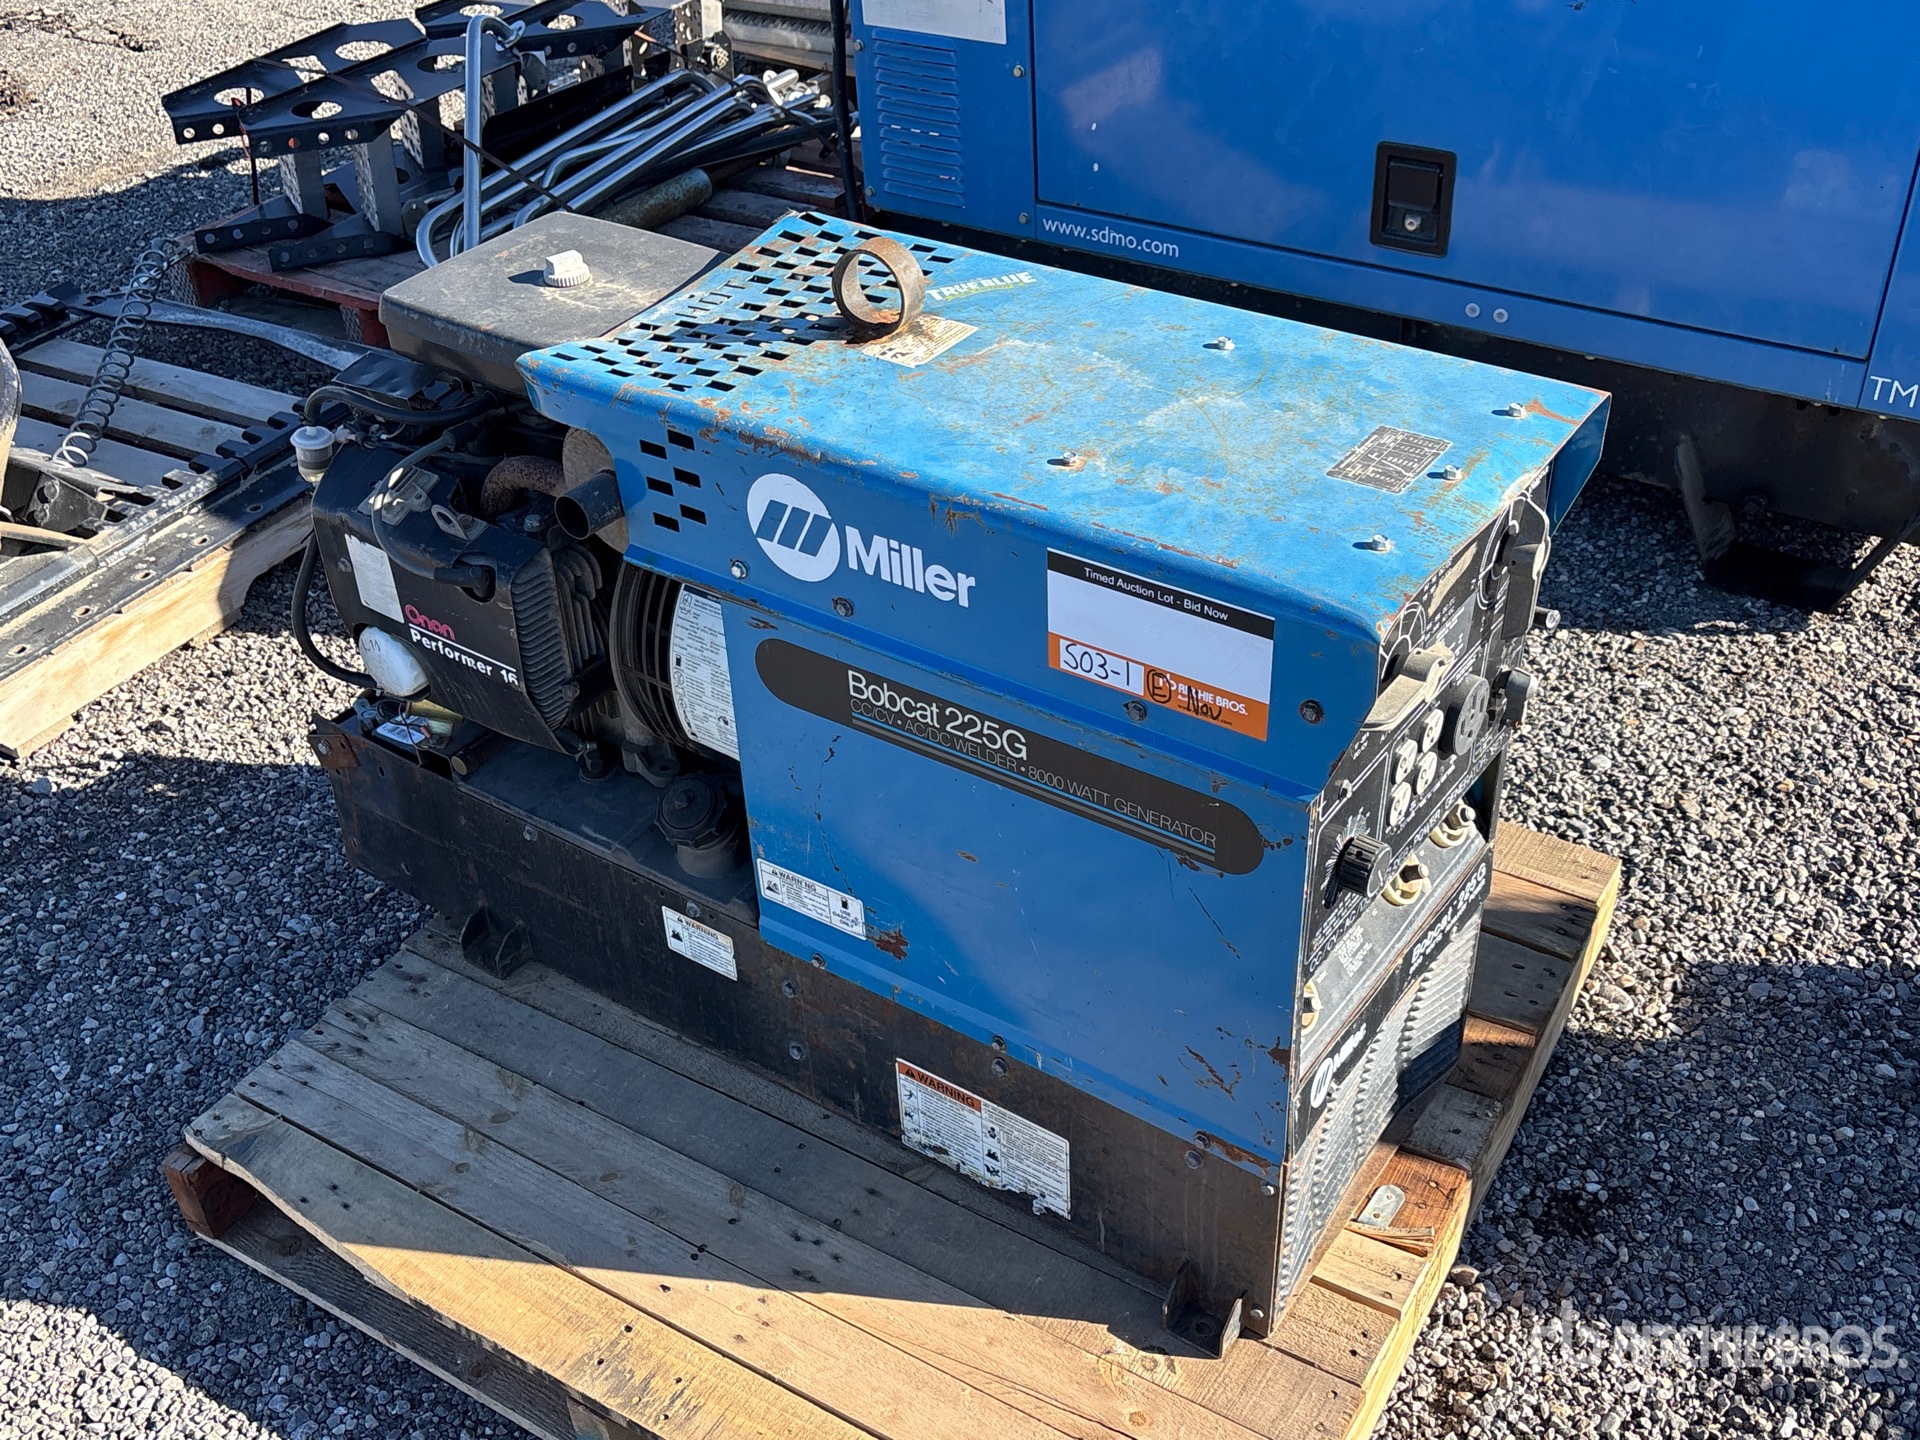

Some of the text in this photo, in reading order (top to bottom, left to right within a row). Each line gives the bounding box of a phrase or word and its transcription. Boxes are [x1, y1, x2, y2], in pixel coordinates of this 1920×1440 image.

[1042, 218, 1179, 258] www.sdmo.com
[925, 271, 1037, 301] TRUE BLUE
[1870, 375, 1919, 408] TM
[845, 525, 976, 608] Miller
[1084, 567, 1114, 585] Timed
[1117, 579, 1155, 598] Auction
[1158, 591, 1174, 604] Lot
[1184, 598, 1201, 612] Bid
[1204, 605, 1229, 620] Now
[405, 604, 455, 640] Onan
[410, 628, 493, 676] Performer
[848, 669, 1027, 760] Bobcat 225G
[1187, 685, 1222, 720] Nov
[1216, 695, 1249, 715] BROS.
[850, 699, 1217, 849] CC/CV AC/DC WELDER 8000 WATT GENERATOR
[1411, 906, 1453, 964] Bobcat
[917, 1071, 975, 1107] WARNING
